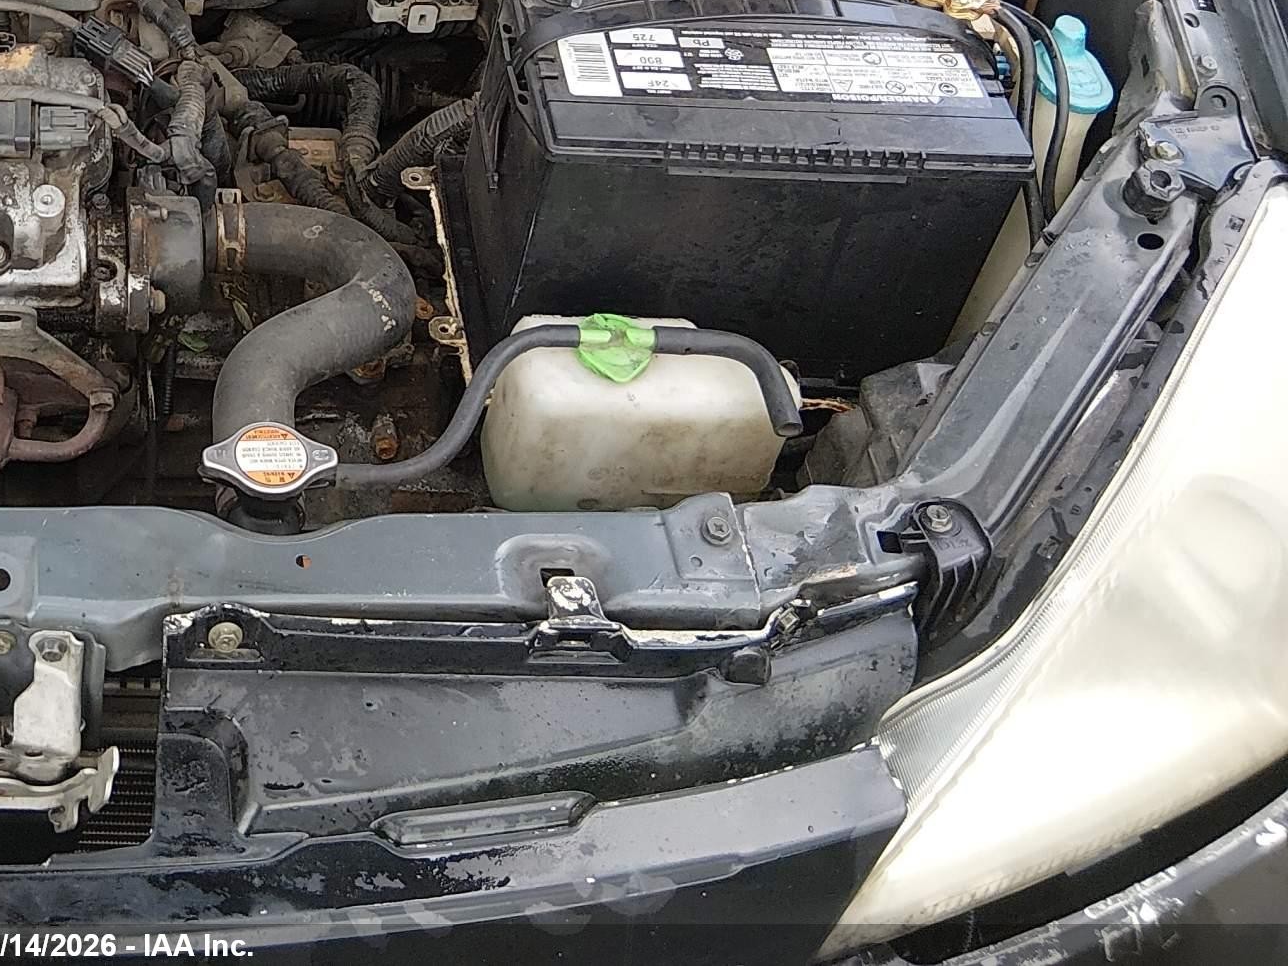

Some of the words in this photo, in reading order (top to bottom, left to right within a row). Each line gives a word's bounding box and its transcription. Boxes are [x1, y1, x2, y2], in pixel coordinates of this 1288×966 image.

[632, 33, 656, 42] 725
[692, 39, 710, 47] Pb
[647, 80, 669, 88] 24F
[831, 93, 929, 104] DANGER/POISON
